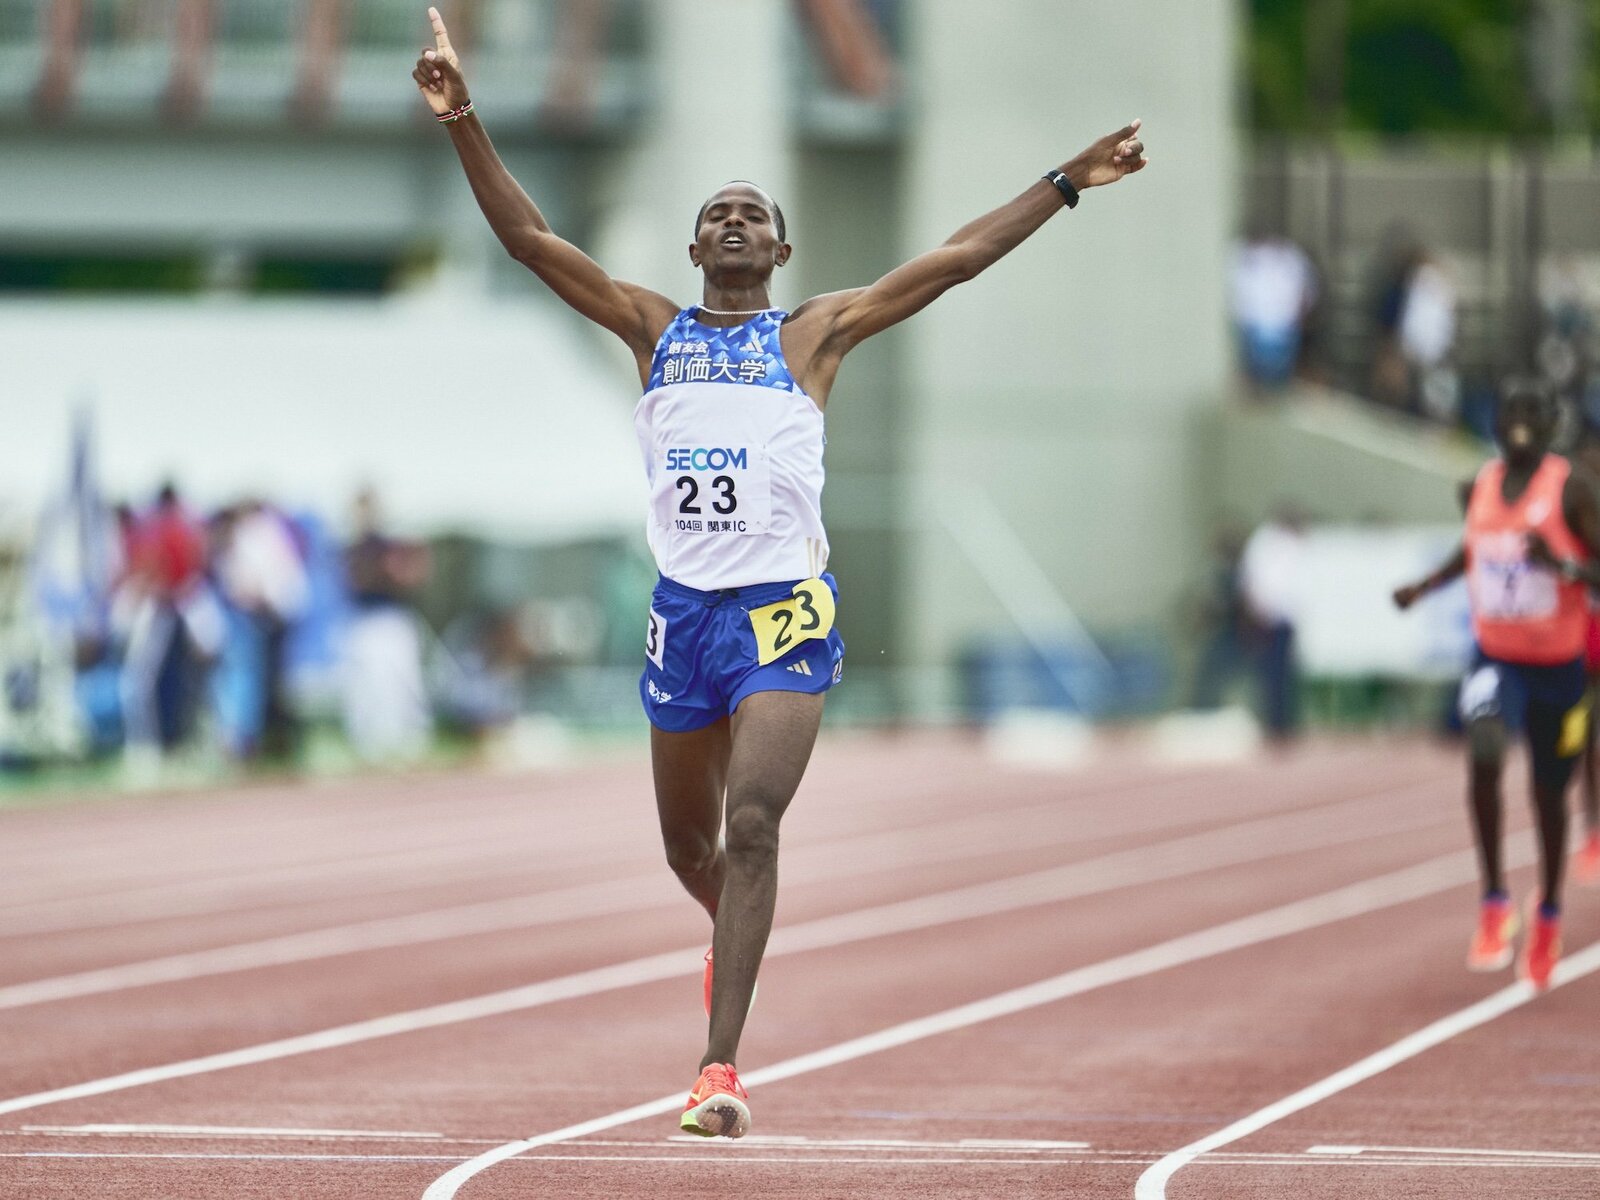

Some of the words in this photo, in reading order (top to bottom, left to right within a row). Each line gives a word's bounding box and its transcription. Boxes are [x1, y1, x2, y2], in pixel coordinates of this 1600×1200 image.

[662, 357, 766, 384] 創価大学
[666, 448, 747, 471] SECOM
[676, 475, 737, 515] 23
[771, 590, 820, 652] 23
